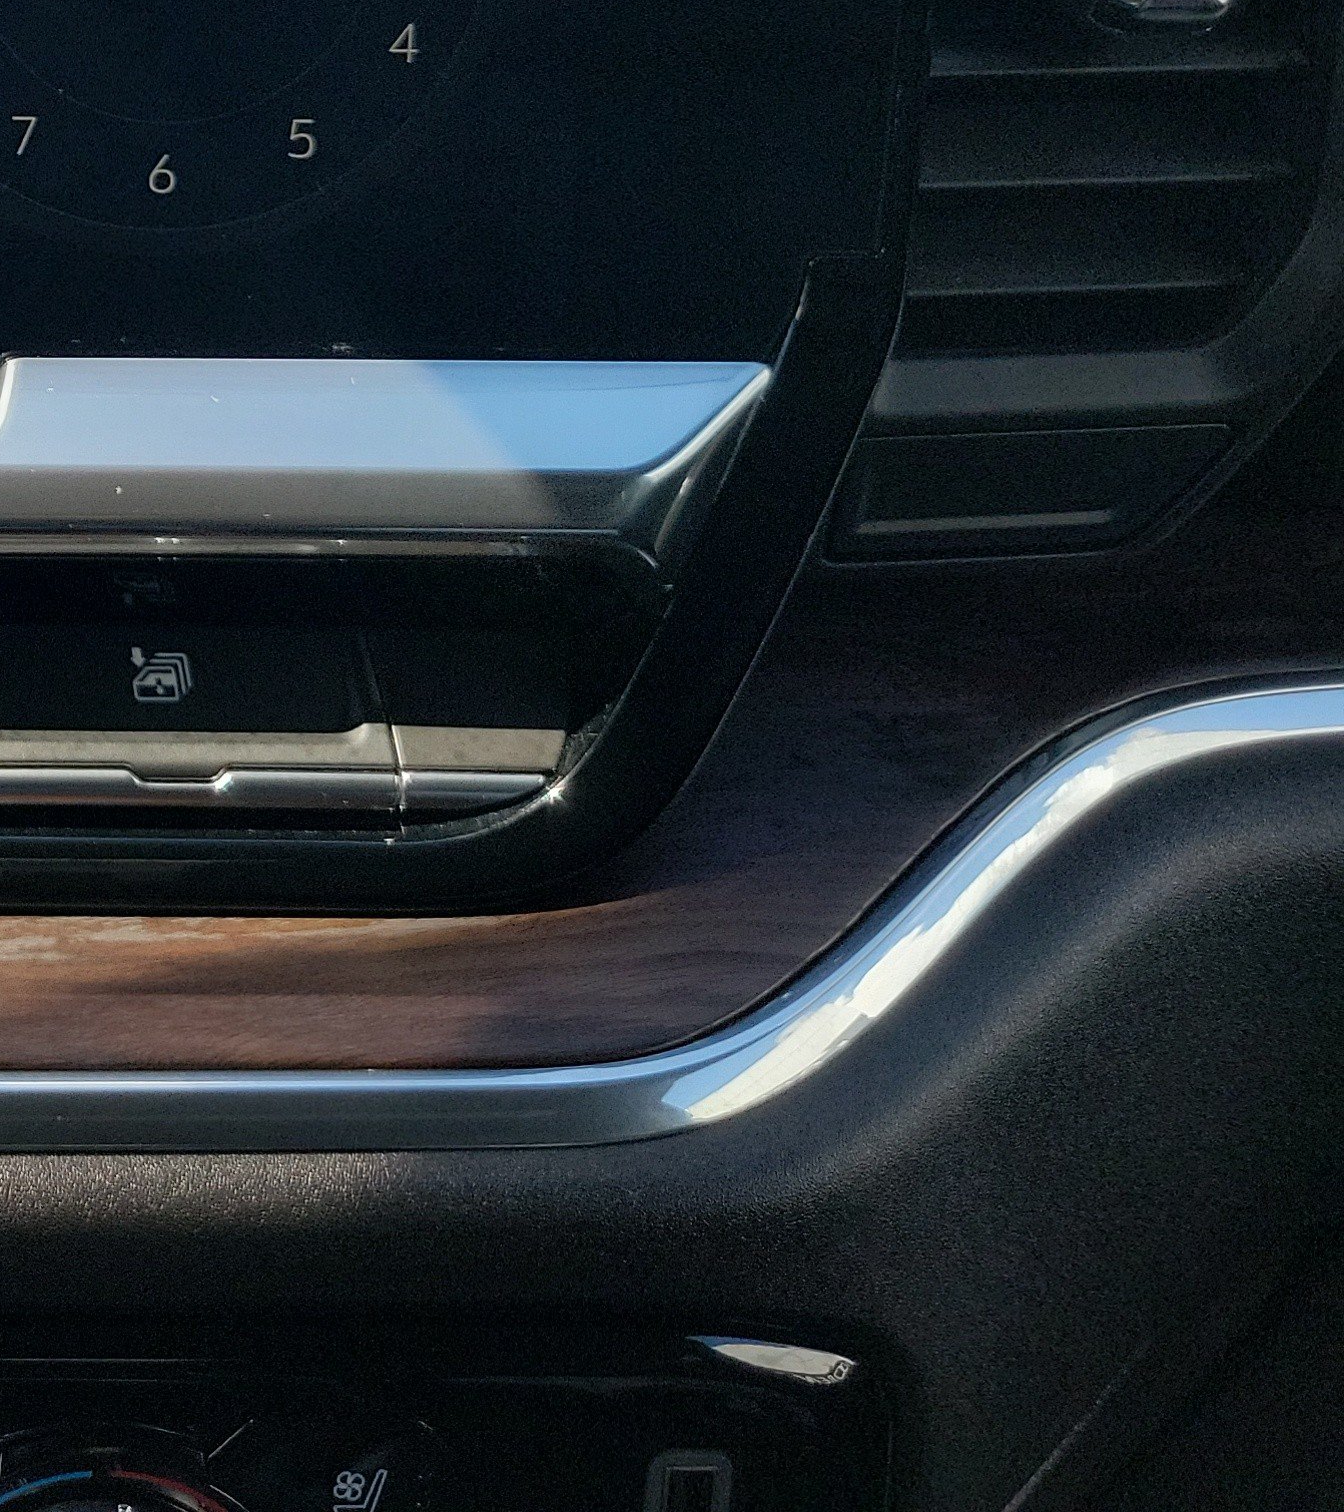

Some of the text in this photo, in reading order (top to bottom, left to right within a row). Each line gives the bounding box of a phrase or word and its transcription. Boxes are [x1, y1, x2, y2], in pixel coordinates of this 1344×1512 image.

[388, 23, 419, 64] 4
[11, 115, 37, 155] 7
[287, 118, 316, 159] 5
[147, 154, 176, 194] 6
